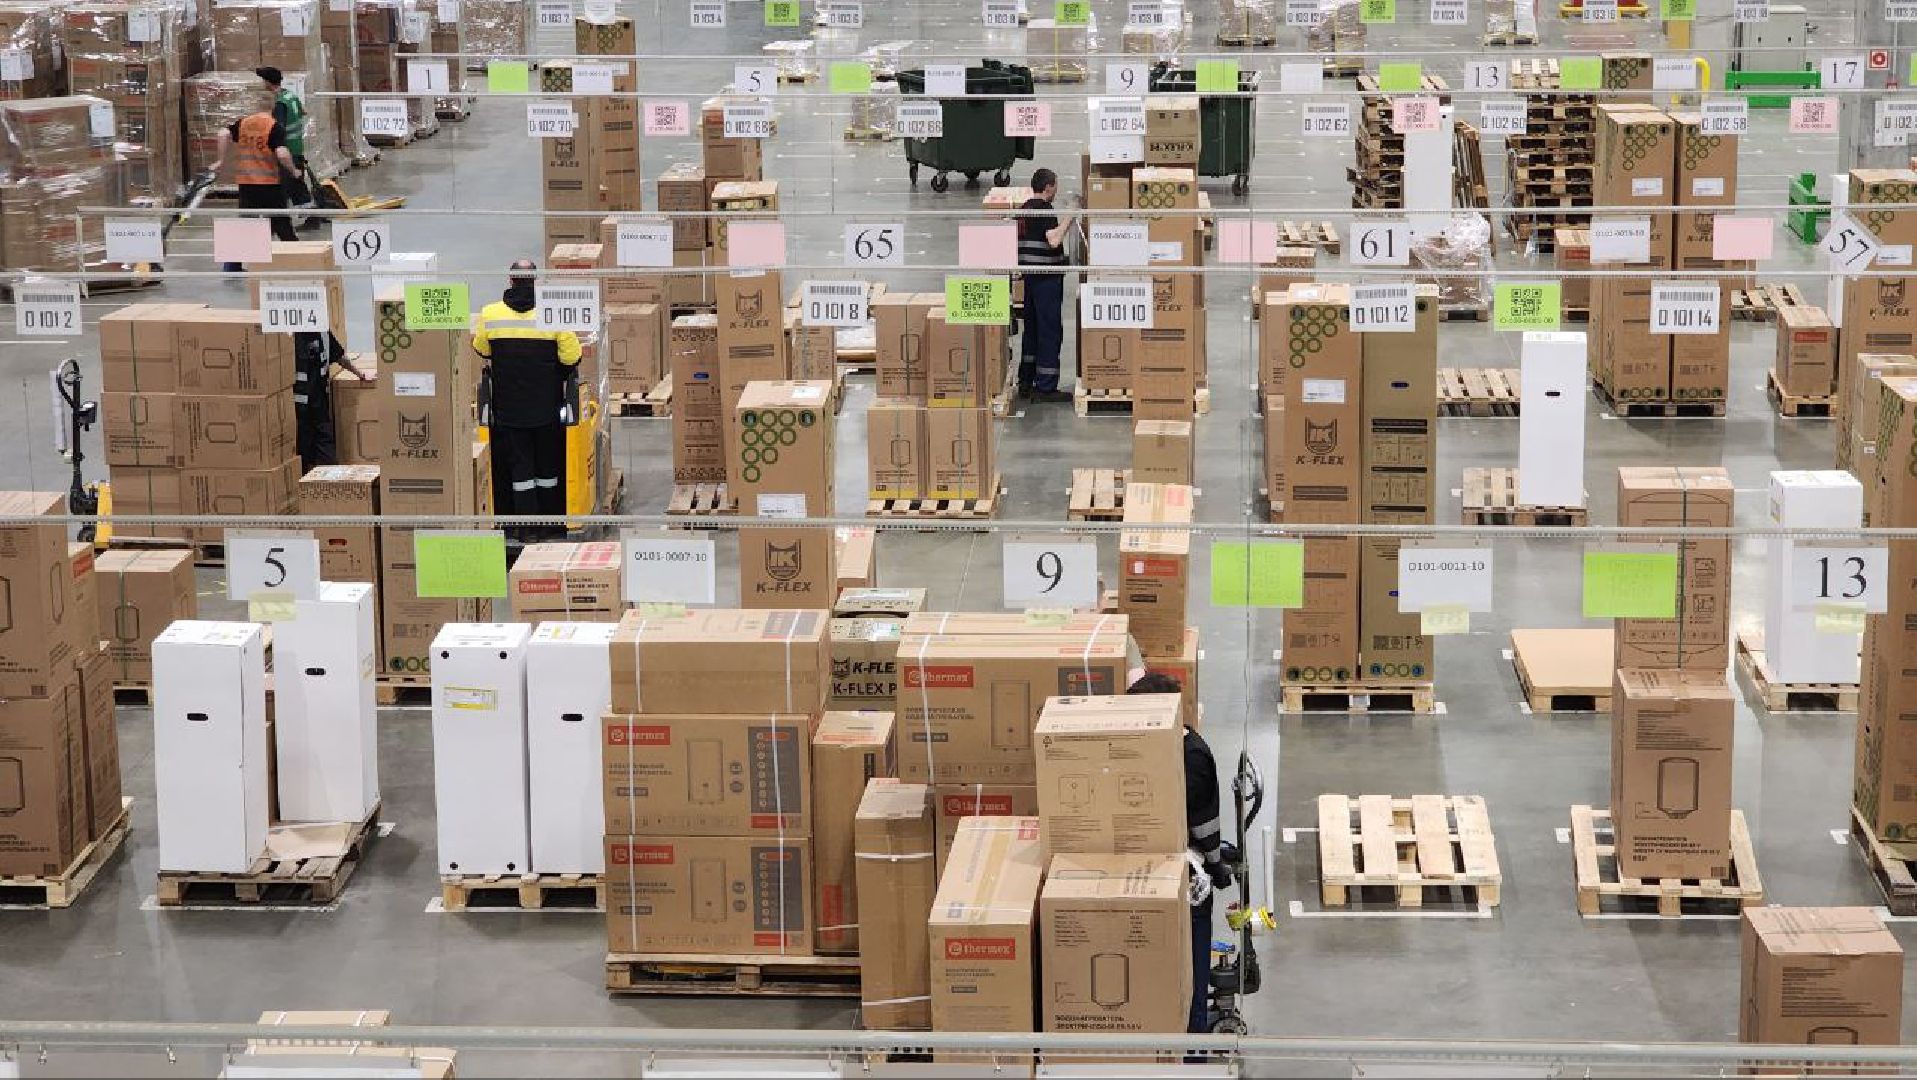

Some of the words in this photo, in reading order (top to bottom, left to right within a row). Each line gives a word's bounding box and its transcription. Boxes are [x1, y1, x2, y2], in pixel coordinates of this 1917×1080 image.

[748, 71, 760, 92] 5
[1121, 68, 1133, 88] 9
[343, 229, 381, 260] 69
[855, 229, 893, 259] 65
[1360, 229, 1395, 259] 61
[1829, 229, 1870, 265] 57
[1295, 455, 1344, 465] K-FLEX
[264, 547, 286, 587] 5
[1037, 552, 1063, 593] 9
[1816, 557, 1867, 597] 13
[756, 583, 812, 593] K-FLEX
[852, 662, 896, 675] K-FLE
[833, 683, 884, 696] K-FLEX
